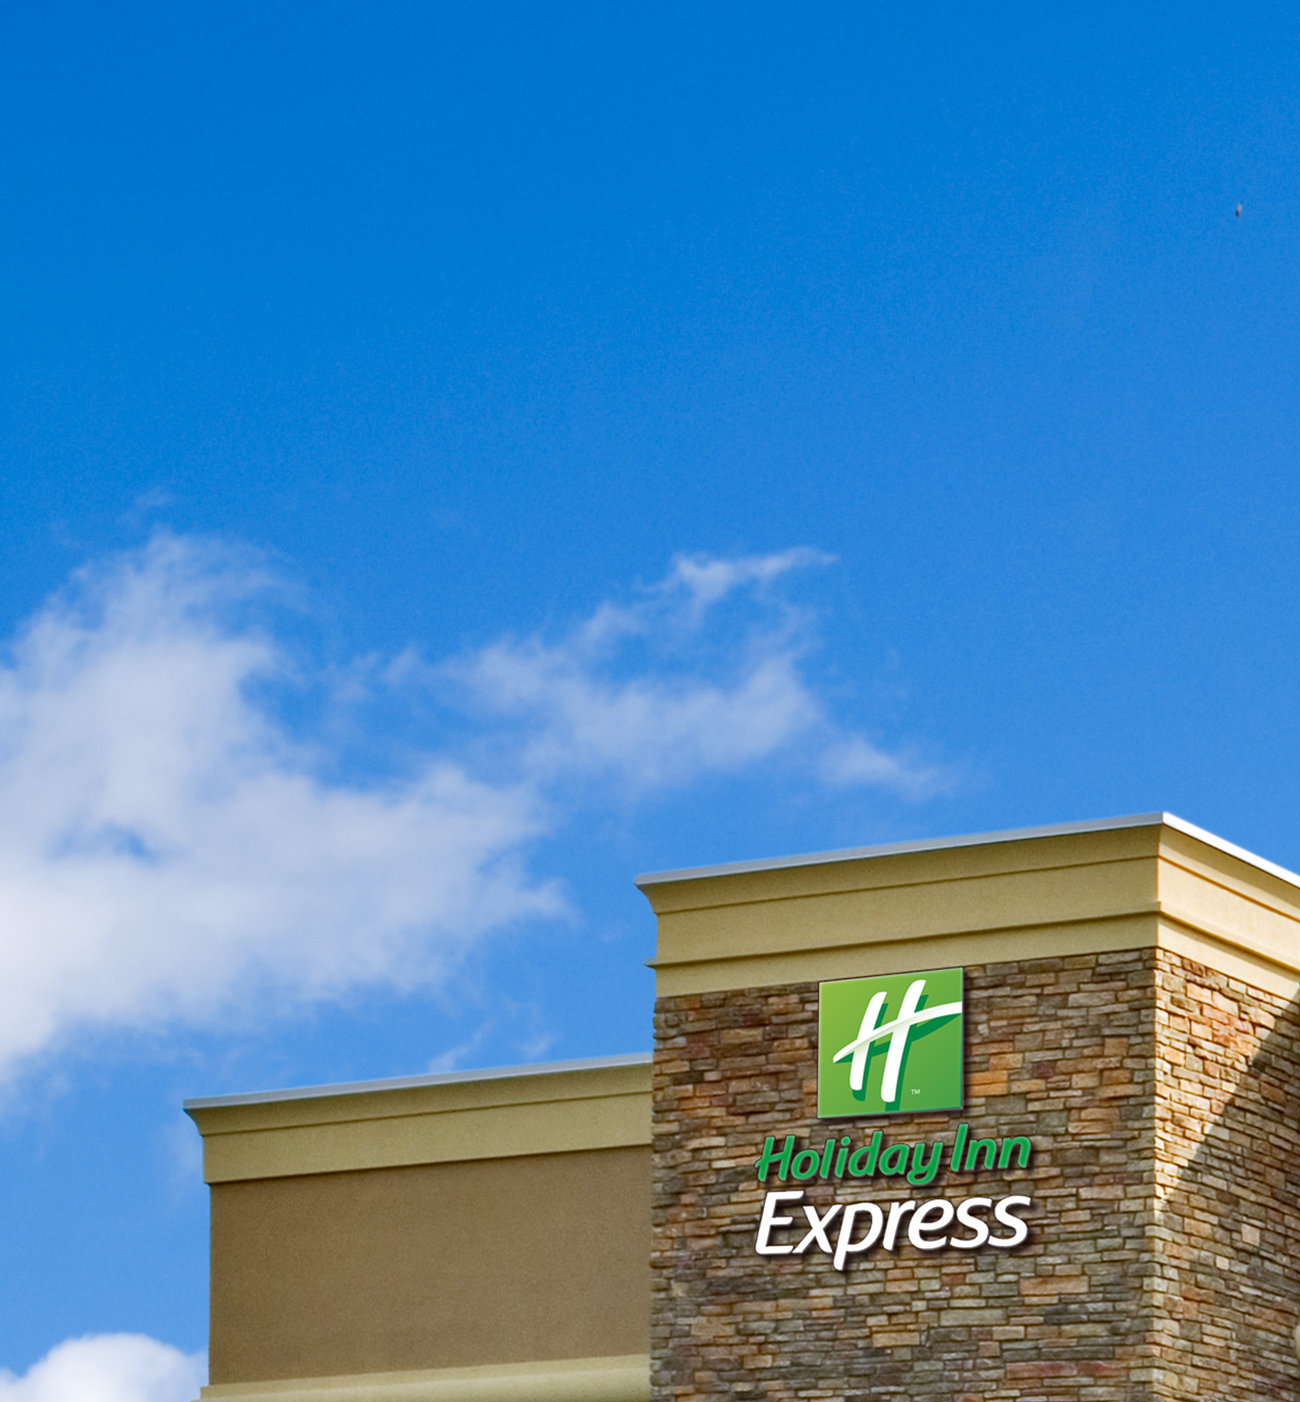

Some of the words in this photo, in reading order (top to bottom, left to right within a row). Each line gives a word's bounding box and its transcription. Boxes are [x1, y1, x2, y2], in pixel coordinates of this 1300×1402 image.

[754, 1130, 944, 1186] Holiday
[950, 1123, 1032, 1173] Inn
[755, 1190, 1032, 1271] Express
